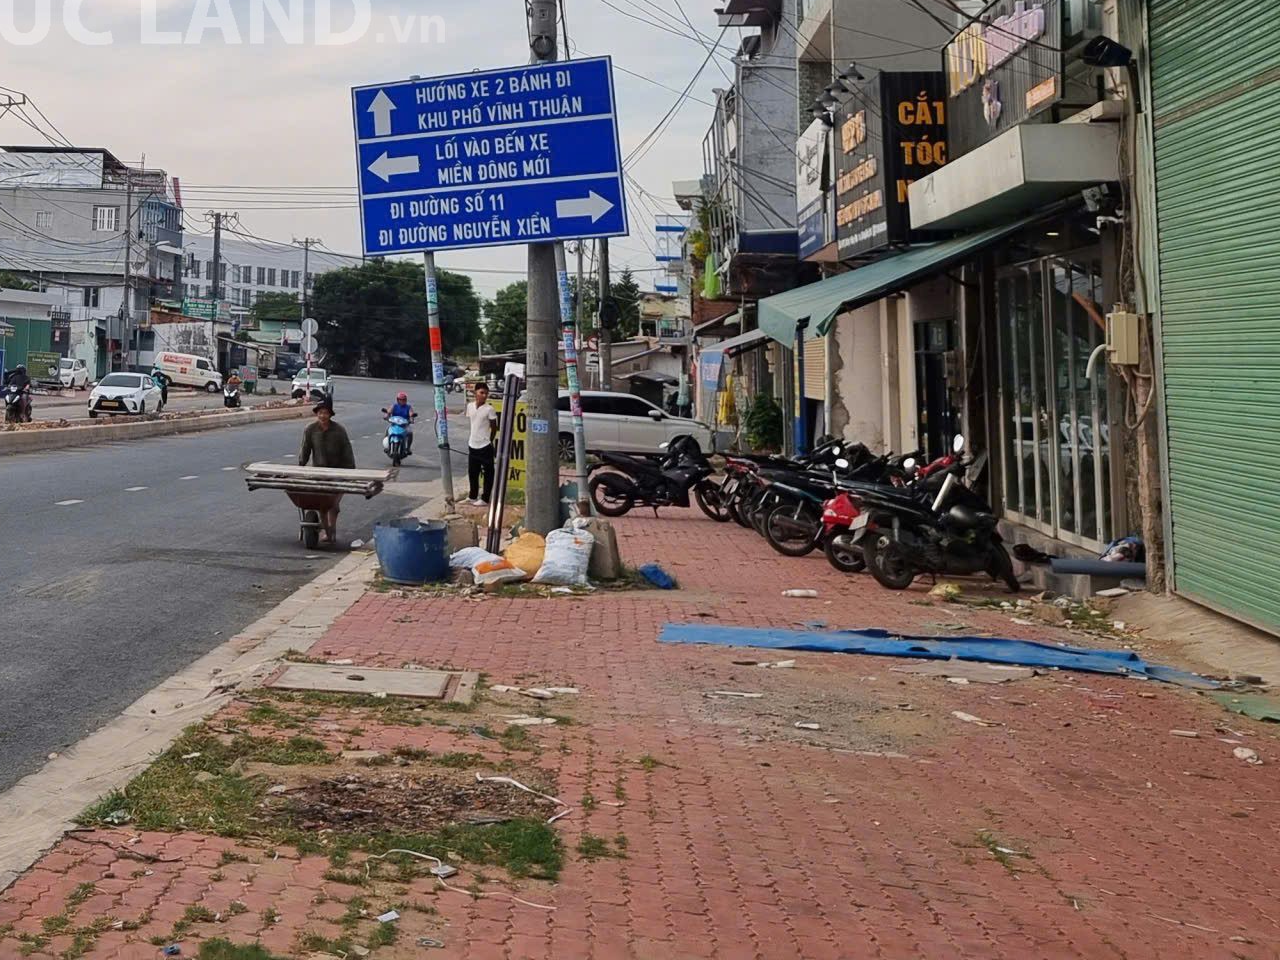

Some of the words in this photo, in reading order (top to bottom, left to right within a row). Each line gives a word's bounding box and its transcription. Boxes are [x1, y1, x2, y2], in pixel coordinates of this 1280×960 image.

[416, 80, 466, 105] HƯỚNG
[471, 78, 489, 98] XE
[496, 78, 504, 95] 2
[509, 71, 551, 94] BÁNH
[556, 69, 571, 89] ĐI
[418, 110, 447, 130] KHU
[452, 102, 483, 126] PHỐ
[487, 99, 524, 123] VĨNH
[528, 95, 583, 119] THUẬN
[435, 137, 458, 161] LỐI
[463, 135, 490, 158] VÀO
[495, 130, 525, 154] BẾN
[530, 132, 549, 152] XE
[437, 162, 472, 185] MIỀN
[478, 159, 517, 182] ĐÔNG
[523, 152, 550, 177] MỚI
[390, 201, 404, 219] ĐI
[409, 194, 460, 218] ĐƯỜNG
[464, 189, 486, 212] SỐ
[489, 193, 505, 211] 11
[378, 228, 393, 247] ĐI
[398, 221, 448, 245] ĐƯỜNG
[453, 214, 511, 241] NGUYỄN
